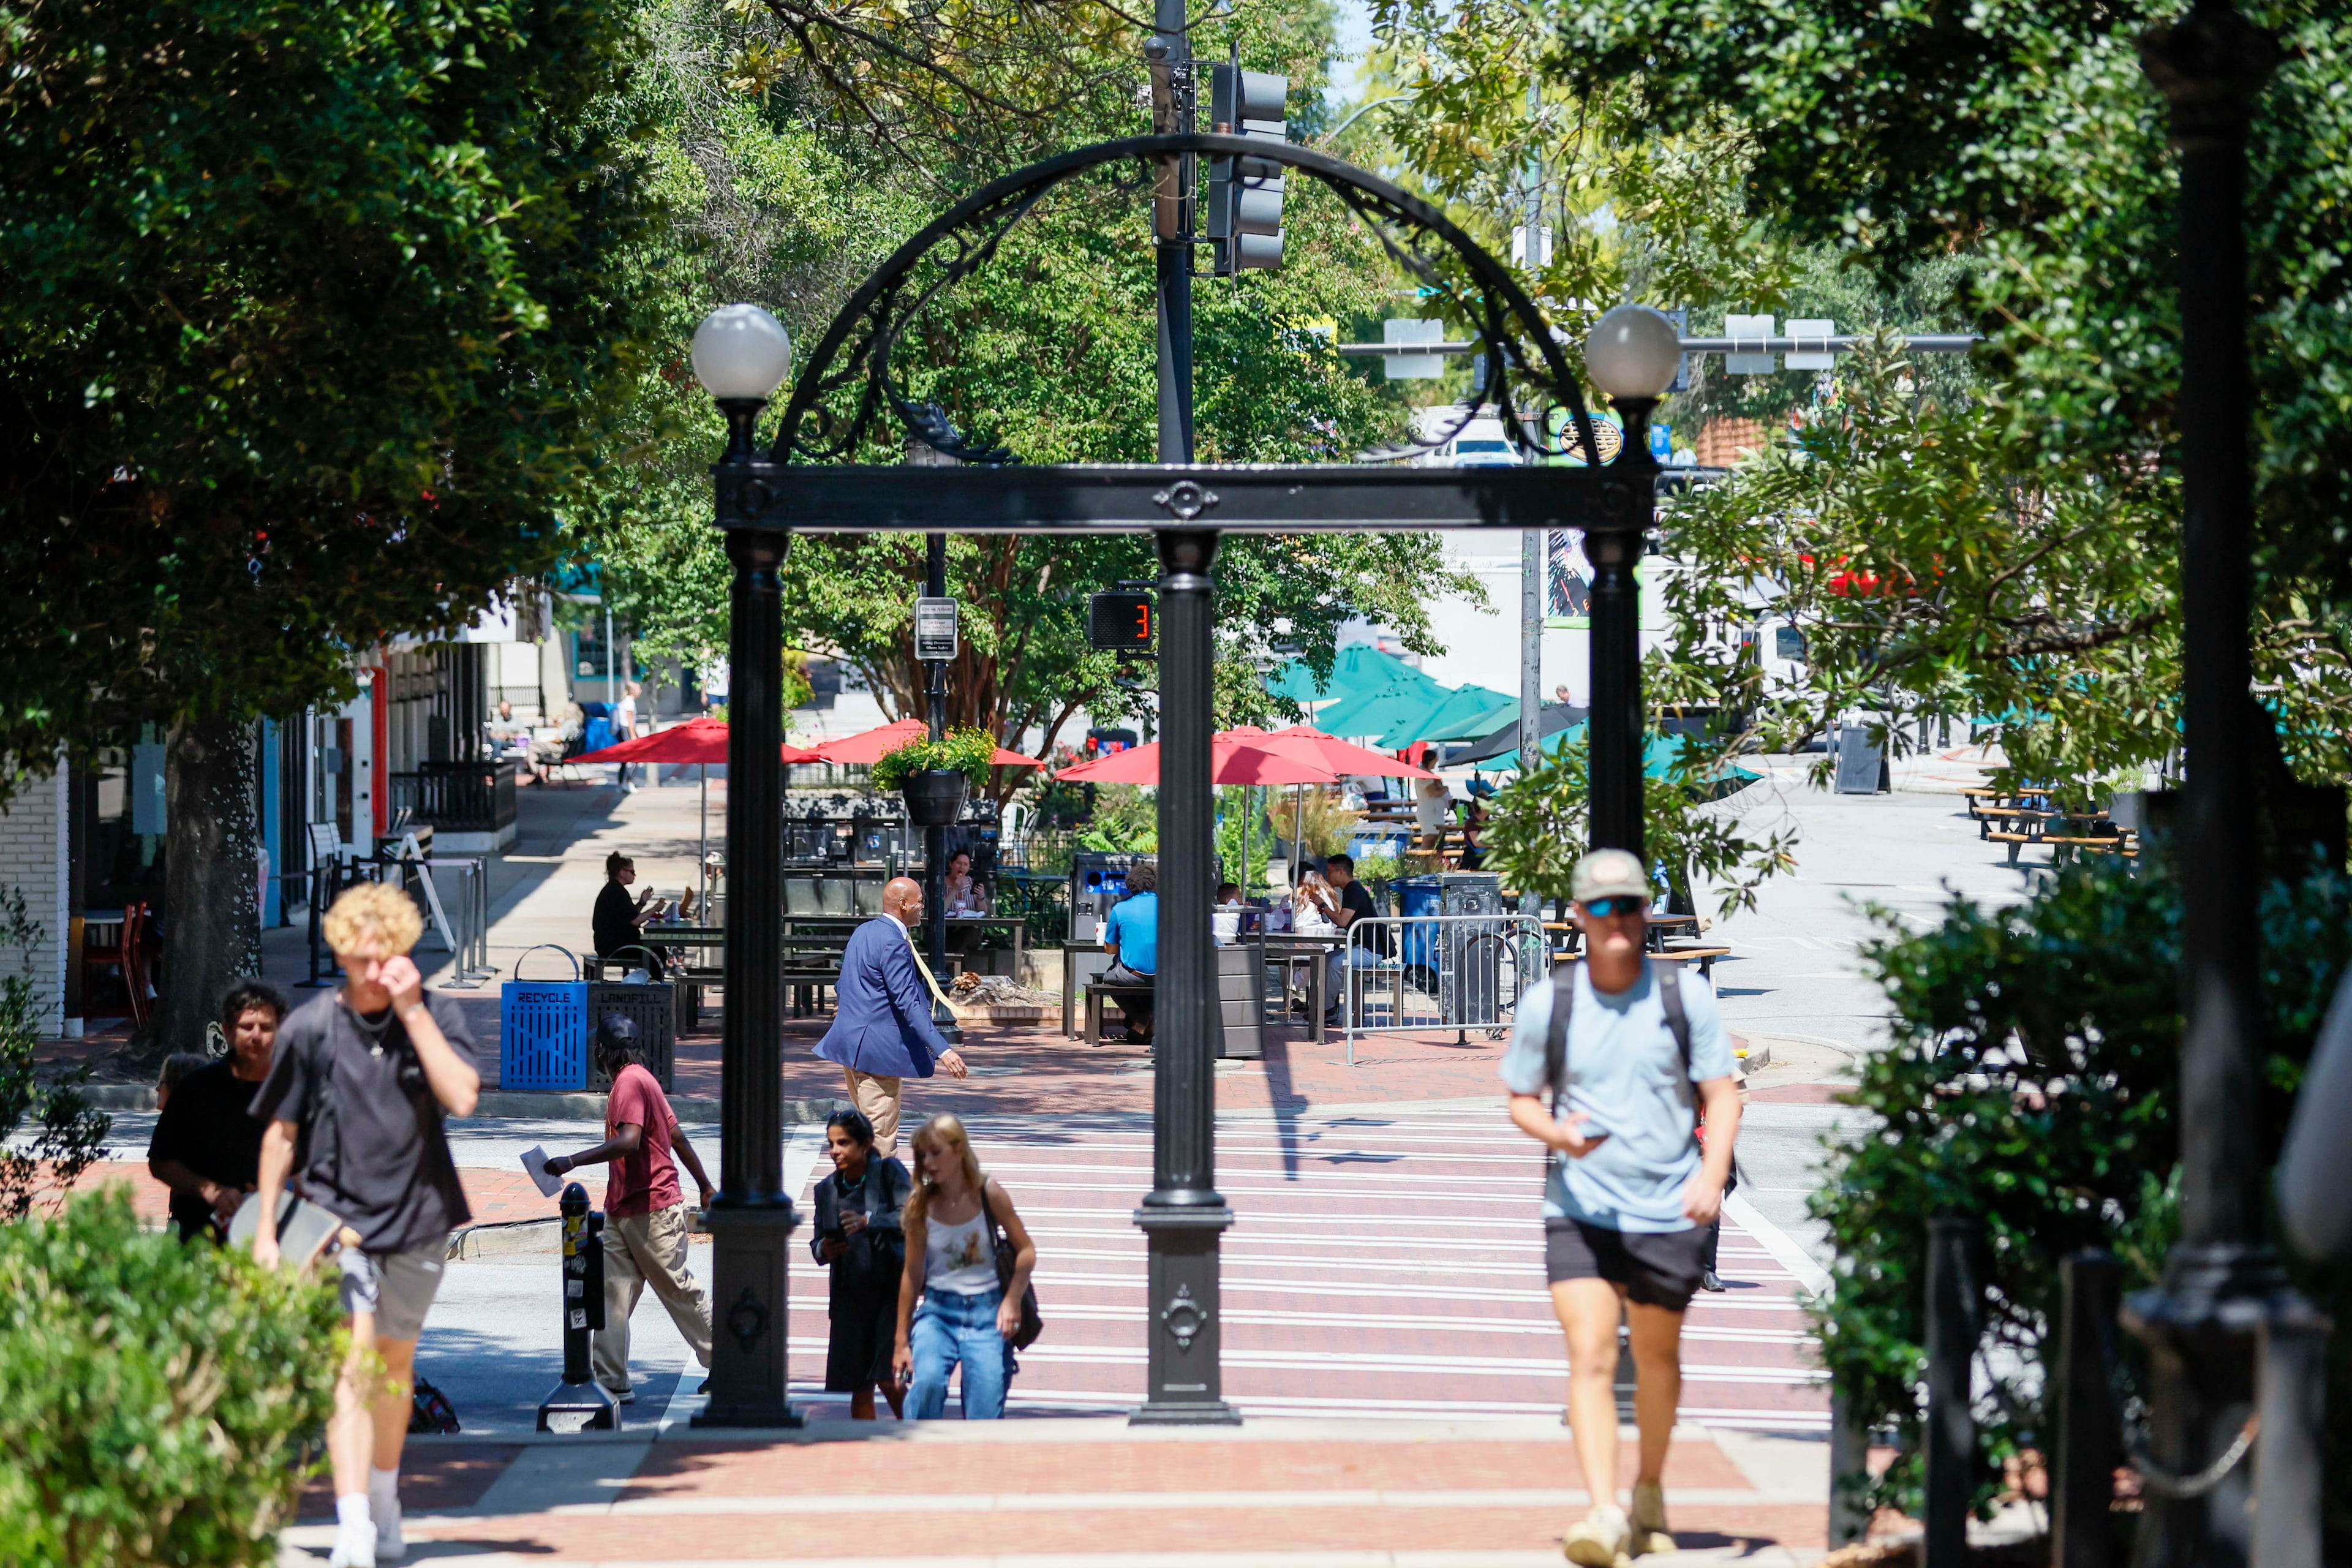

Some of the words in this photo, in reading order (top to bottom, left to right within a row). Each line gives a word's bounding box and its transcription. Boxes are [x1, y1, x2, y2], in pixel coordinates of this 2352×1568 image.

[1136, 605, 1148, 638] 3
[518, 992, 571, 1003] RECYCLE
[600, 993, 661, 1005] LANDFILL
